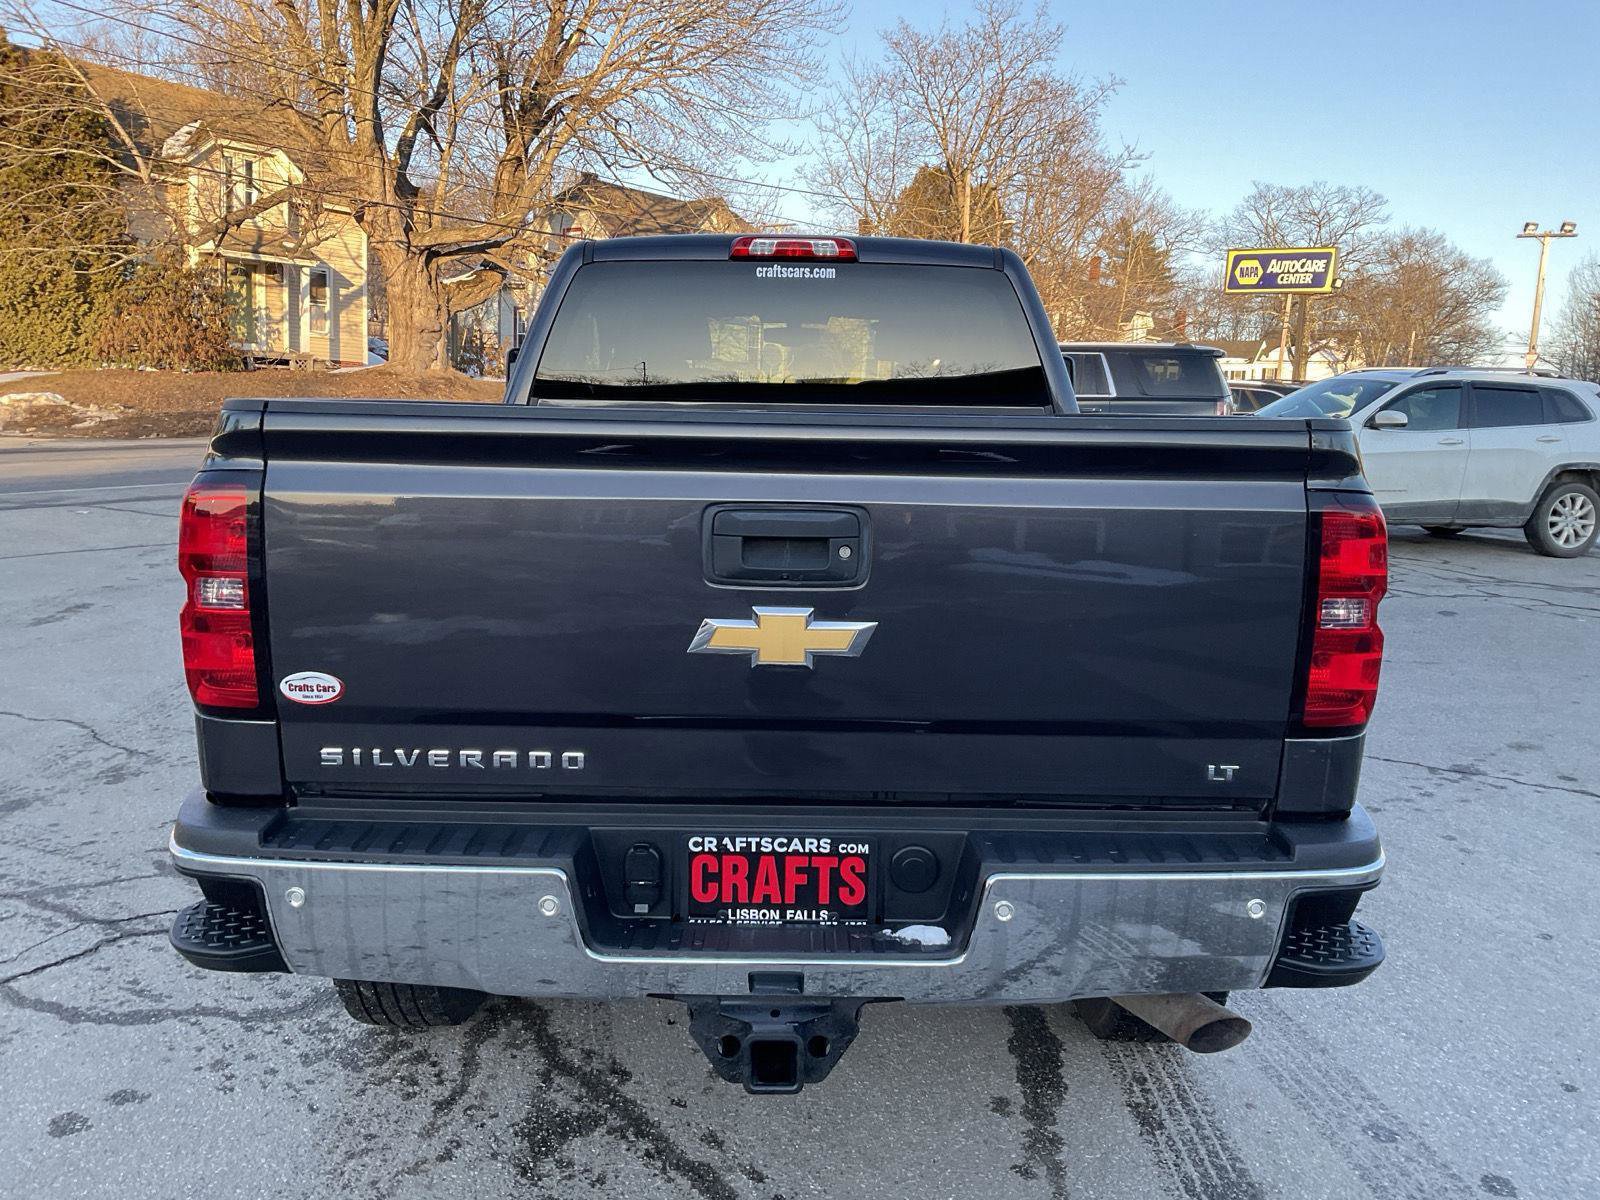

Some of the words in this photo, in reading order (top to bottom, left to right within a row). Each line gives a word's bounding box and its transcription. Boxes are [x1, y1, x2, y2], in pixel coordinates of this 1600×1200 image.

[756, 264, 836, 279] craftscars.com
[1239, 266, 1259, 278] NAPA
[1277, 273, 1314, 285] CENTER
[288, 683, 315, 692] Crafts
[316, 684, 336, 693] Cars
[320, 748, 585, 769] SILVERADO
[1208, 764, 1240, 781] LT
[688, 836, 832, 853] CRAFTSCARS
[691, 854, 866, 906] CRAFTS
[728, 908, 780, 921] LISBON
[786, 909, 829, 921] FALLS
